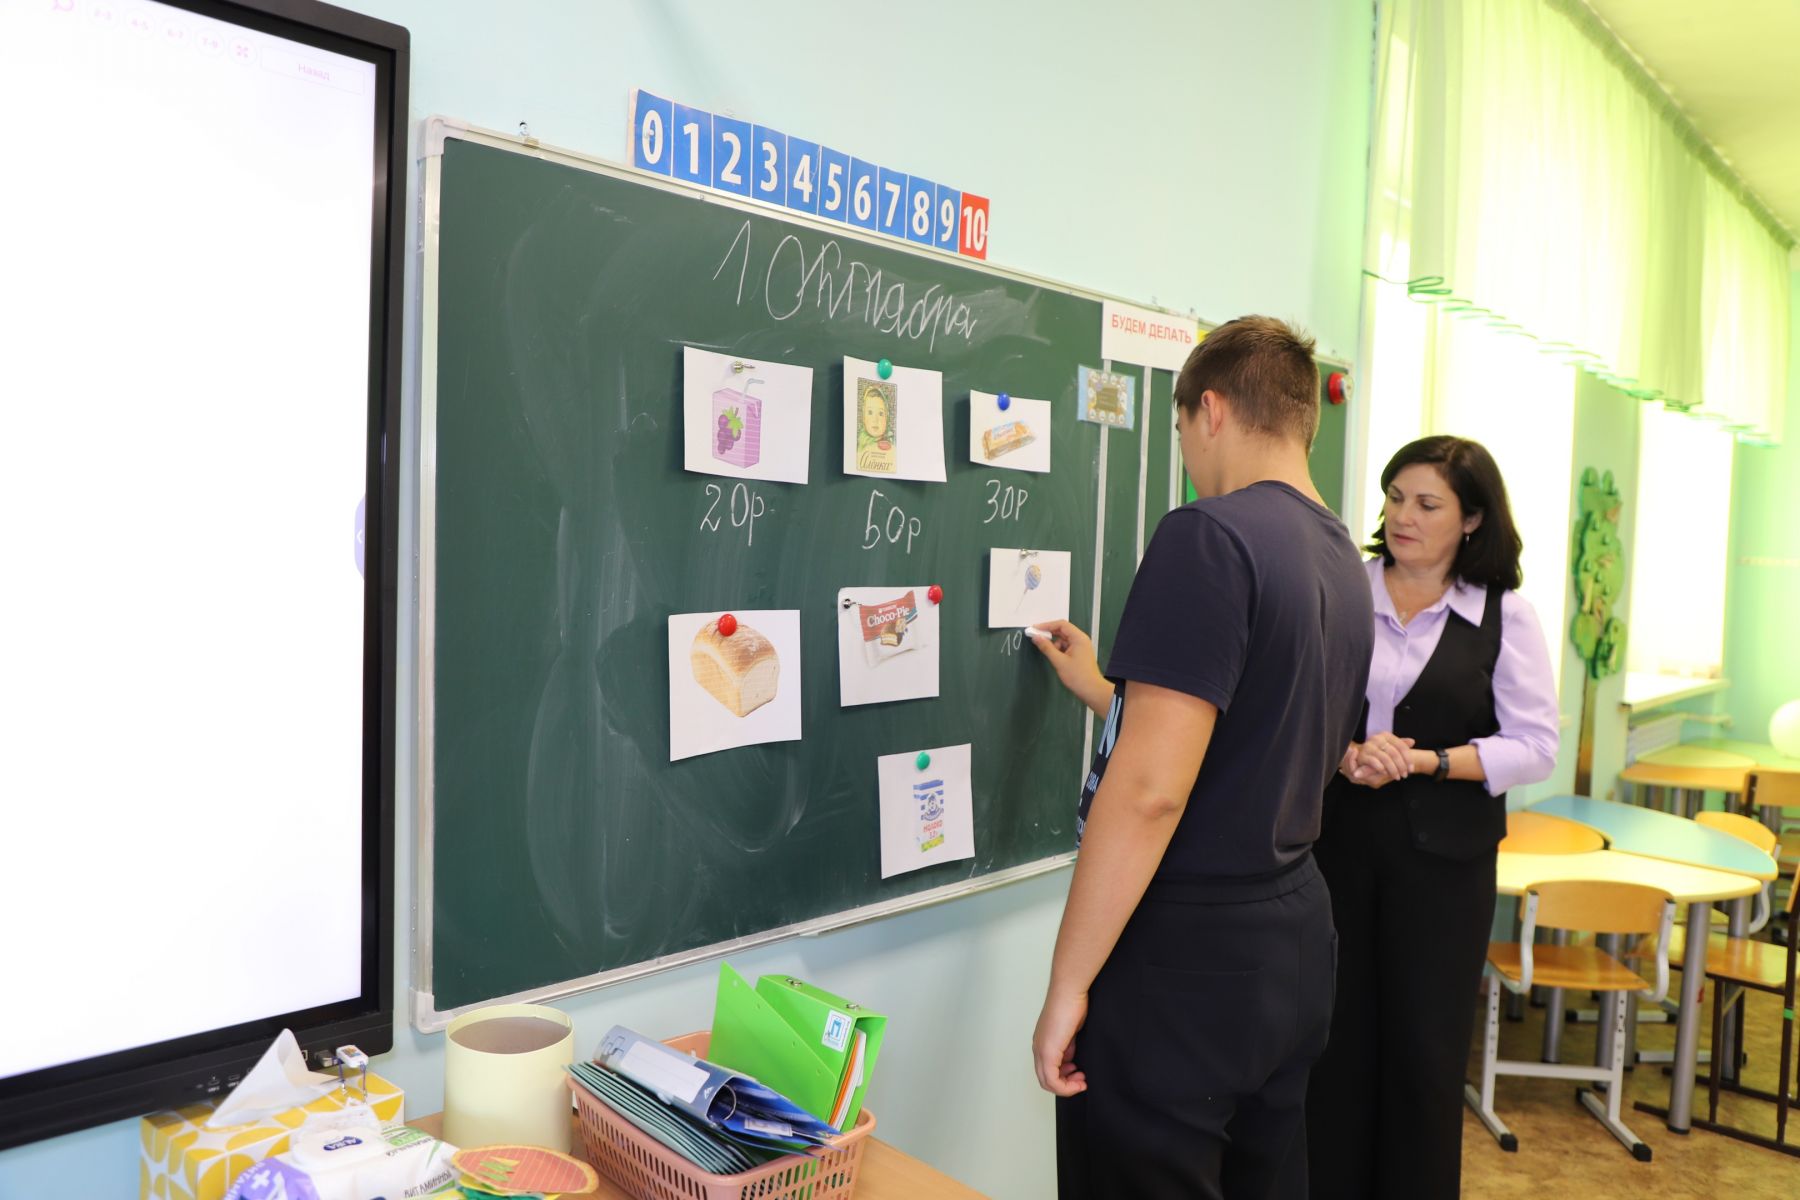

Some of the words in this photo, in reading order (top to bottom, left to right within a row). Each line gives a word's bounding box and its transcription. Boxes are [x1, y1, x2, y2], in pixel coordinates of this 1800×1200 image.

[641, 109, 664, 165] 0
[683, 122, 699, 175] 1
[720, 131, 742, 185] 2
[760, 141, 778, 193] 3
[793, 154, 813, 204] 4
[824, 162, 842, 211] 5
[853, 175, 872, 221] 6
[885, 181, 901, 228] 7
[912, 190, 930, 236] 8
[941, 199, 955, 242] 9
[963, 206, 986, 252] 10
[712, 220, 751, 306] 1
[1111, 313, 1147, 336] БУДЕМ
[1149, 323, 1193, 345] ДЕЛАТЬ
[866, 605, 910, 628] Choco-Pie
[1000, 630, 1023, 657] 10
